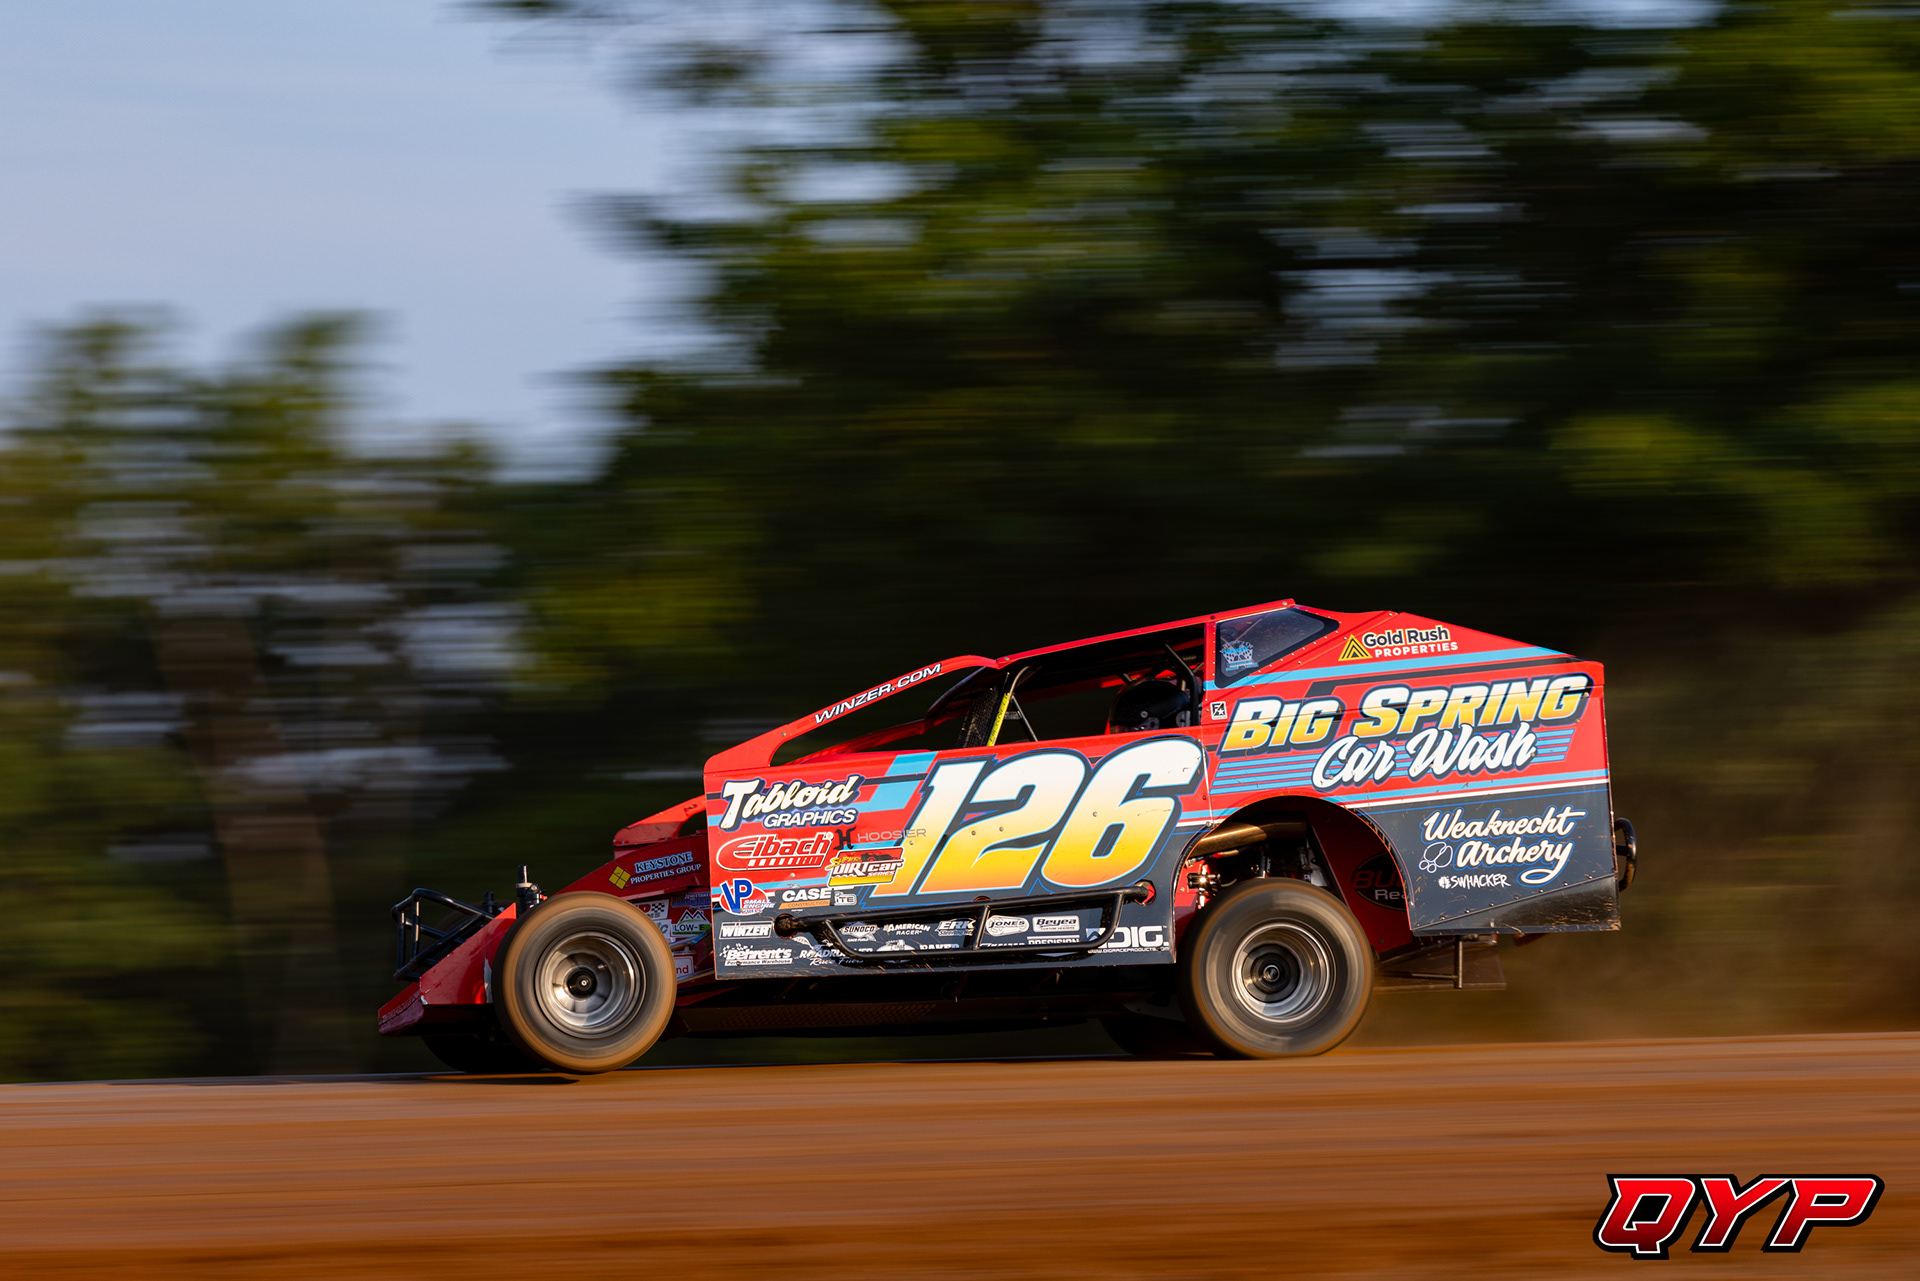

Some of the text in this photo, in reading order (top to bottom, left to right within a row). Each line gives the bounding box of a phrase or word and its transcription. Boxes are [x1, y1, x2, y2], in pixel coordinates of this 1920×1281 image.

[1362, 625, 1450, 648] Gold Rush
[1374, 642, 1459, 658] PROPERTIES
[814, 663, 943, 724] WINZER.COM
[1221, 674, 1590, 753] BIG SPRING
[1310, 722, 1537, 789] Car Wash
[719, 775, 863, 829] Tabloid
[763, 809, 858, 829] GRAPHICS
[869, 739, 1202, 898] 126
[1423, 805, 1587, 842] Weaknecht
[857, 828, 927, 842] HOOSIER
[716, 831, 833, 871] Eibach
[634, 851, 693, 874] KEYSTONE
[630, 863, 702, 885] PROPERTIES GROUP
[1450, 873, 1512, 890] SWHACKER
[719, 878, 753, 914] VP
[781, 887, 832, 902] CASE
[722, 924, 770, 938] WINZER
[843, 925, 876, 933] SUNOCO
[888, 923, 931, 933] AMERICAN
[988, 920, 1026, 929] JONES
[1036, 918, 1077, 927] Beyea
[726, 947, 793, 960] Behrent's
